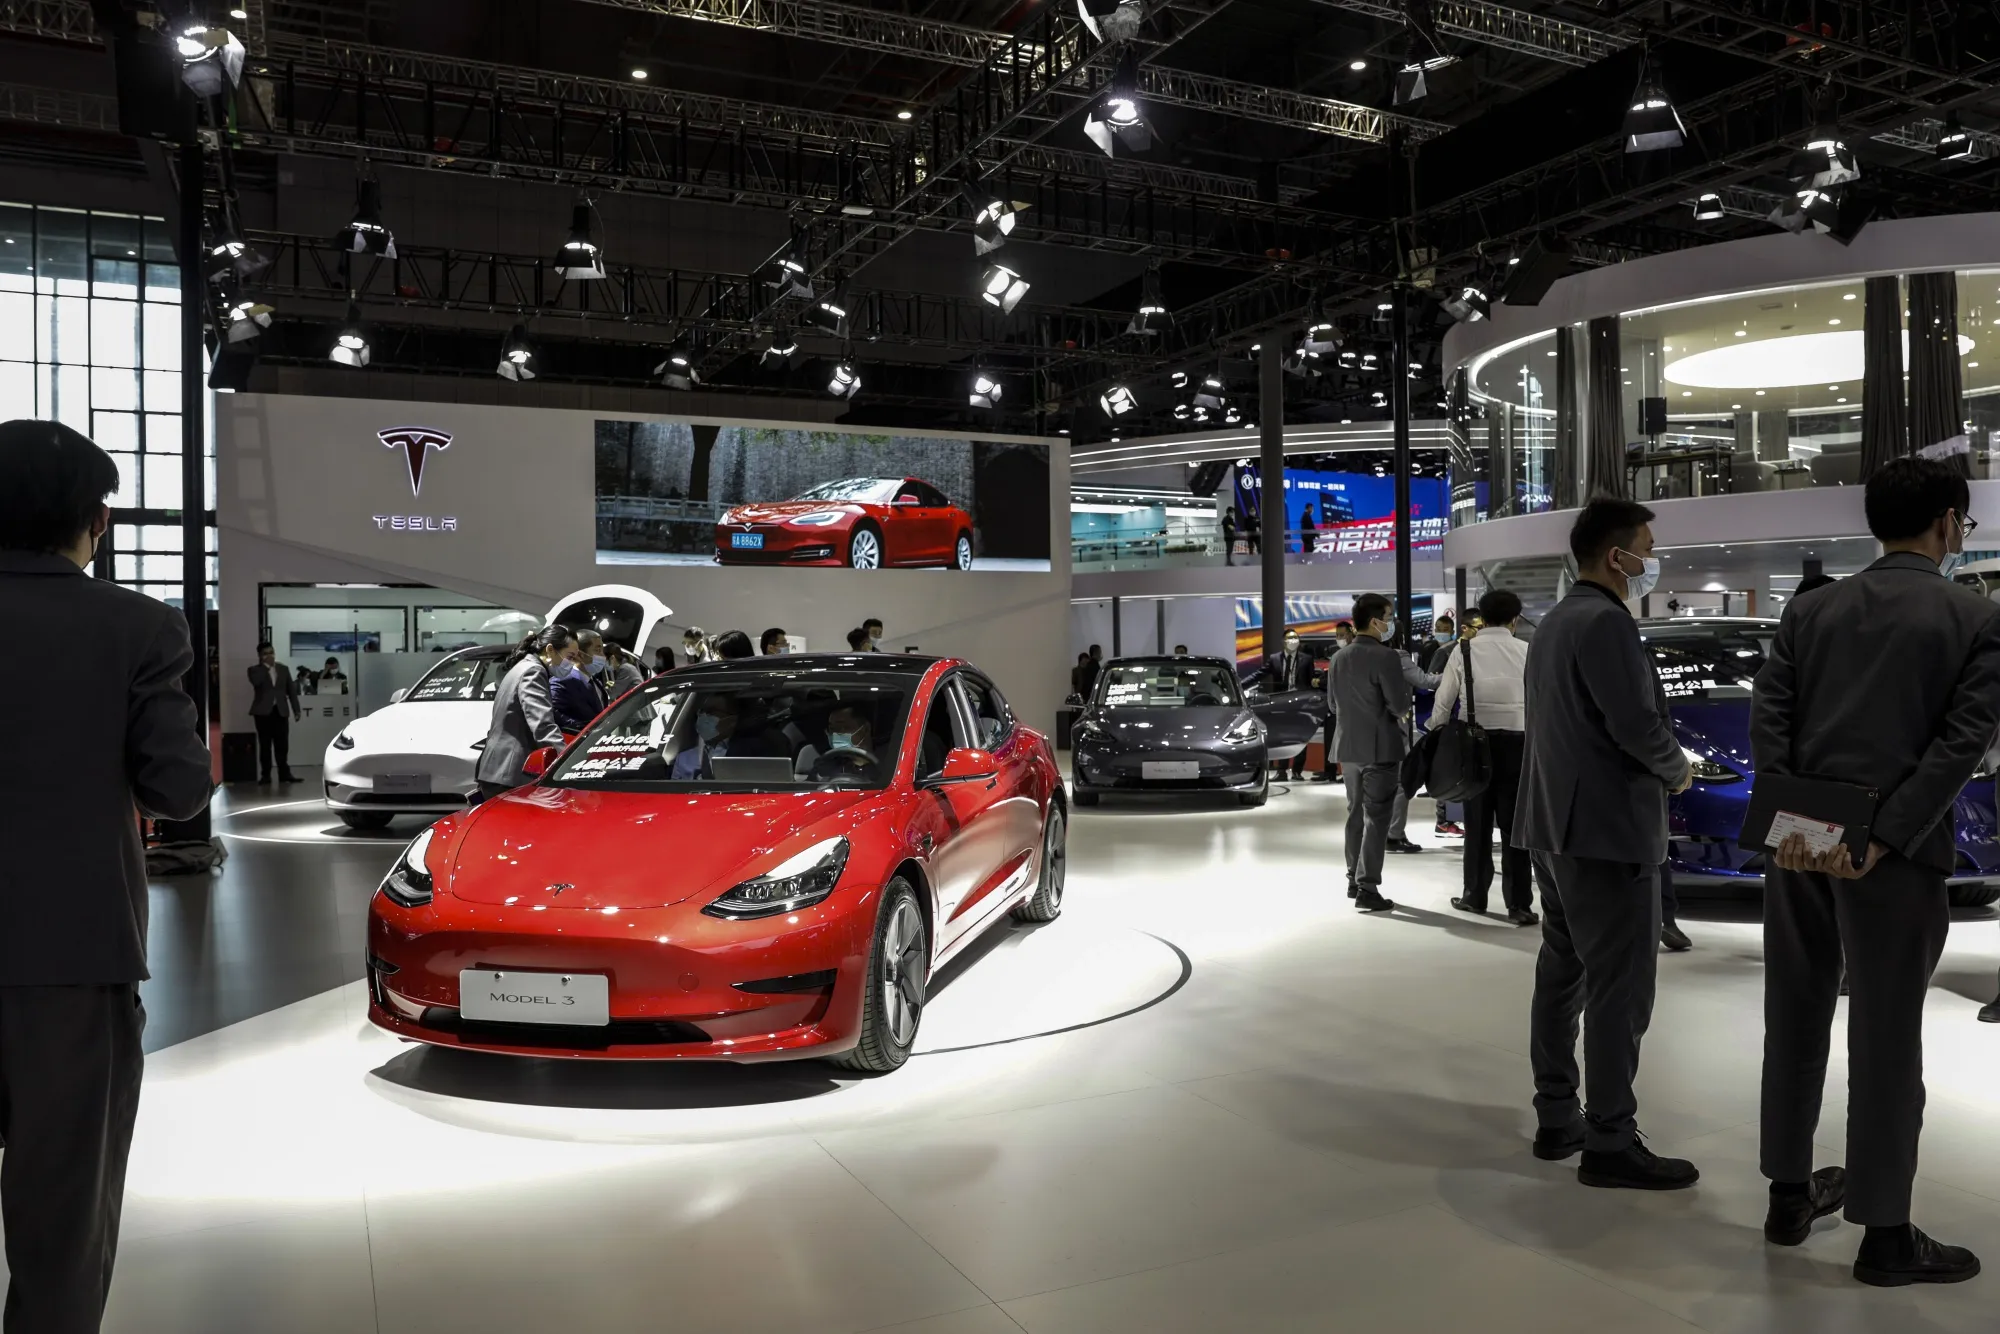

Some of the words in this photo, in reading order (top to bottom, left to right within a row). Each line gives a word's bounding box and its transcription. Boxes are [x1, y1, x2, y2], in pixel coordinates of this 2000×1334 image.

[372, 515, 456, 531] TESLA
[1702, 664, 1715, 672] Y
[594, 734, 655, 745] Mode
[660, 734, 674, 744] 3
[571, 757, 647, 770] 468公里
[490, 992, 556, 1005] MODEL
[561, 995, 575, 1006] 3
